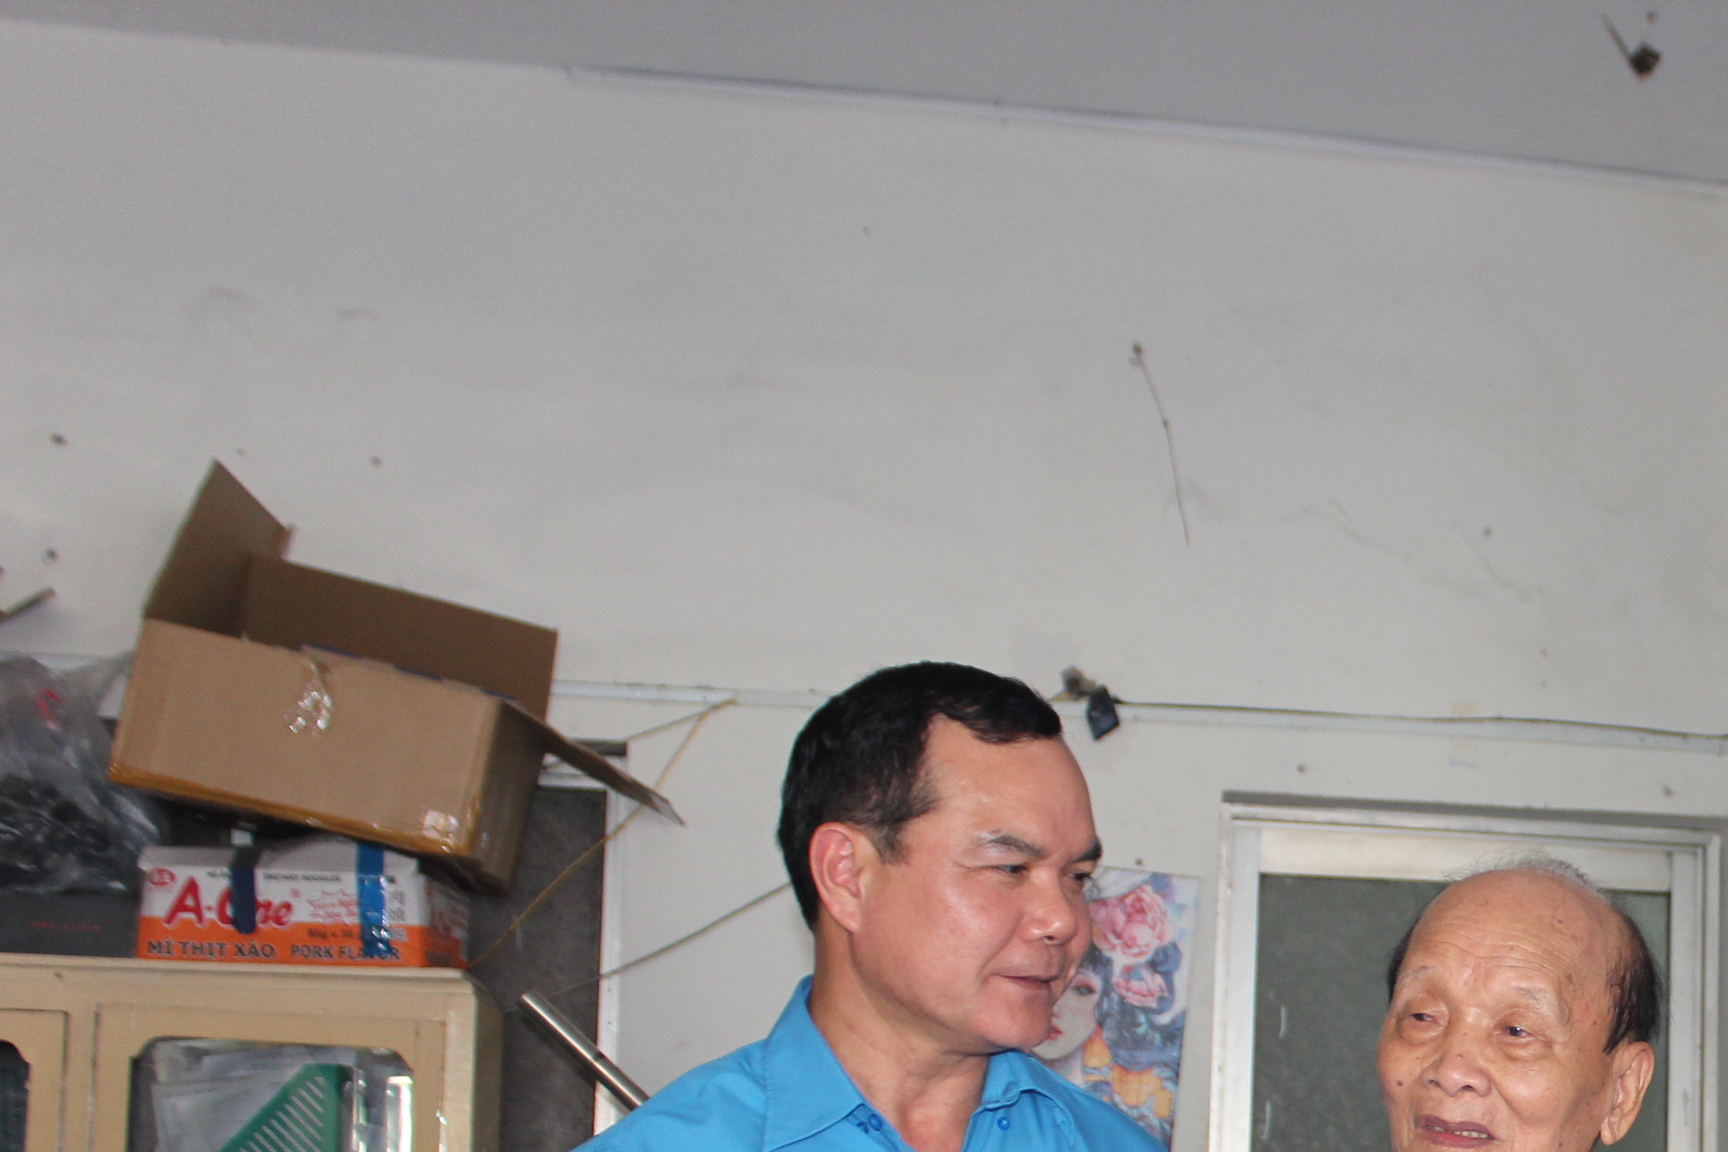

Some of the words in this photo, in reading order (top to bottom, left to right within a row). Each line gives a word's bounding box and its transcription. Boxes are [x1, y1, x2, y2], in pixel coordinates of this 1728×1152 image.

[148, 936, 172, 955] MÌ
[178, 940, 226, 960] THỊT
[233, 938, 276, 958] XÀO
[290, 944, 334, 958] PORK
